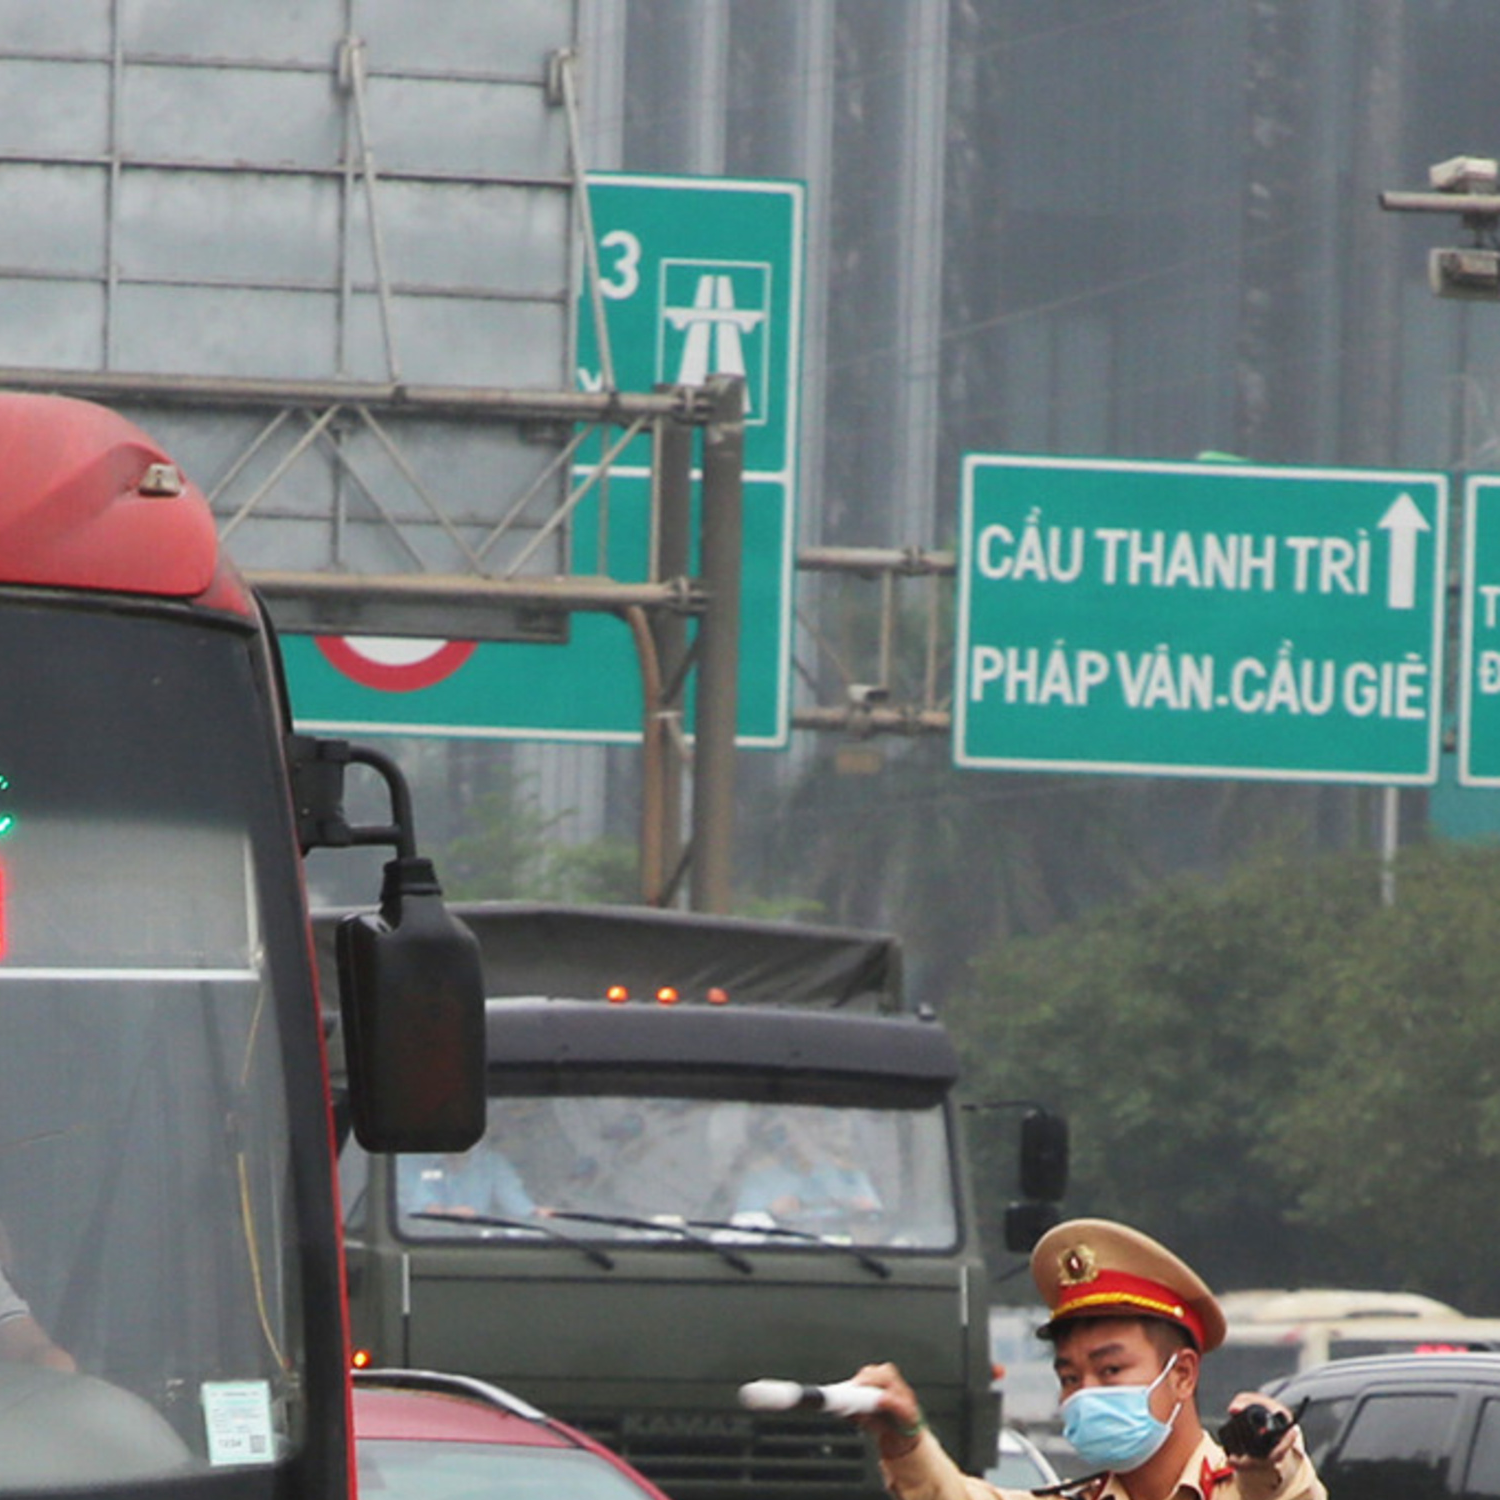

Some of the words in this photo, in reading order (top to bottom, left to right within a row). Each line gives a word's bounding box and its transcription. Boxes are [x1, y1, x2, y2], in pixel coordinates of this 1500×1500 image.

[977, 506, 1084, 584] CẦU
[1094, 528, 1276, 592] THANH
[1285, 528, 1371, 595] TRÌ
[971, 639, 1110, 706] PHÁP
